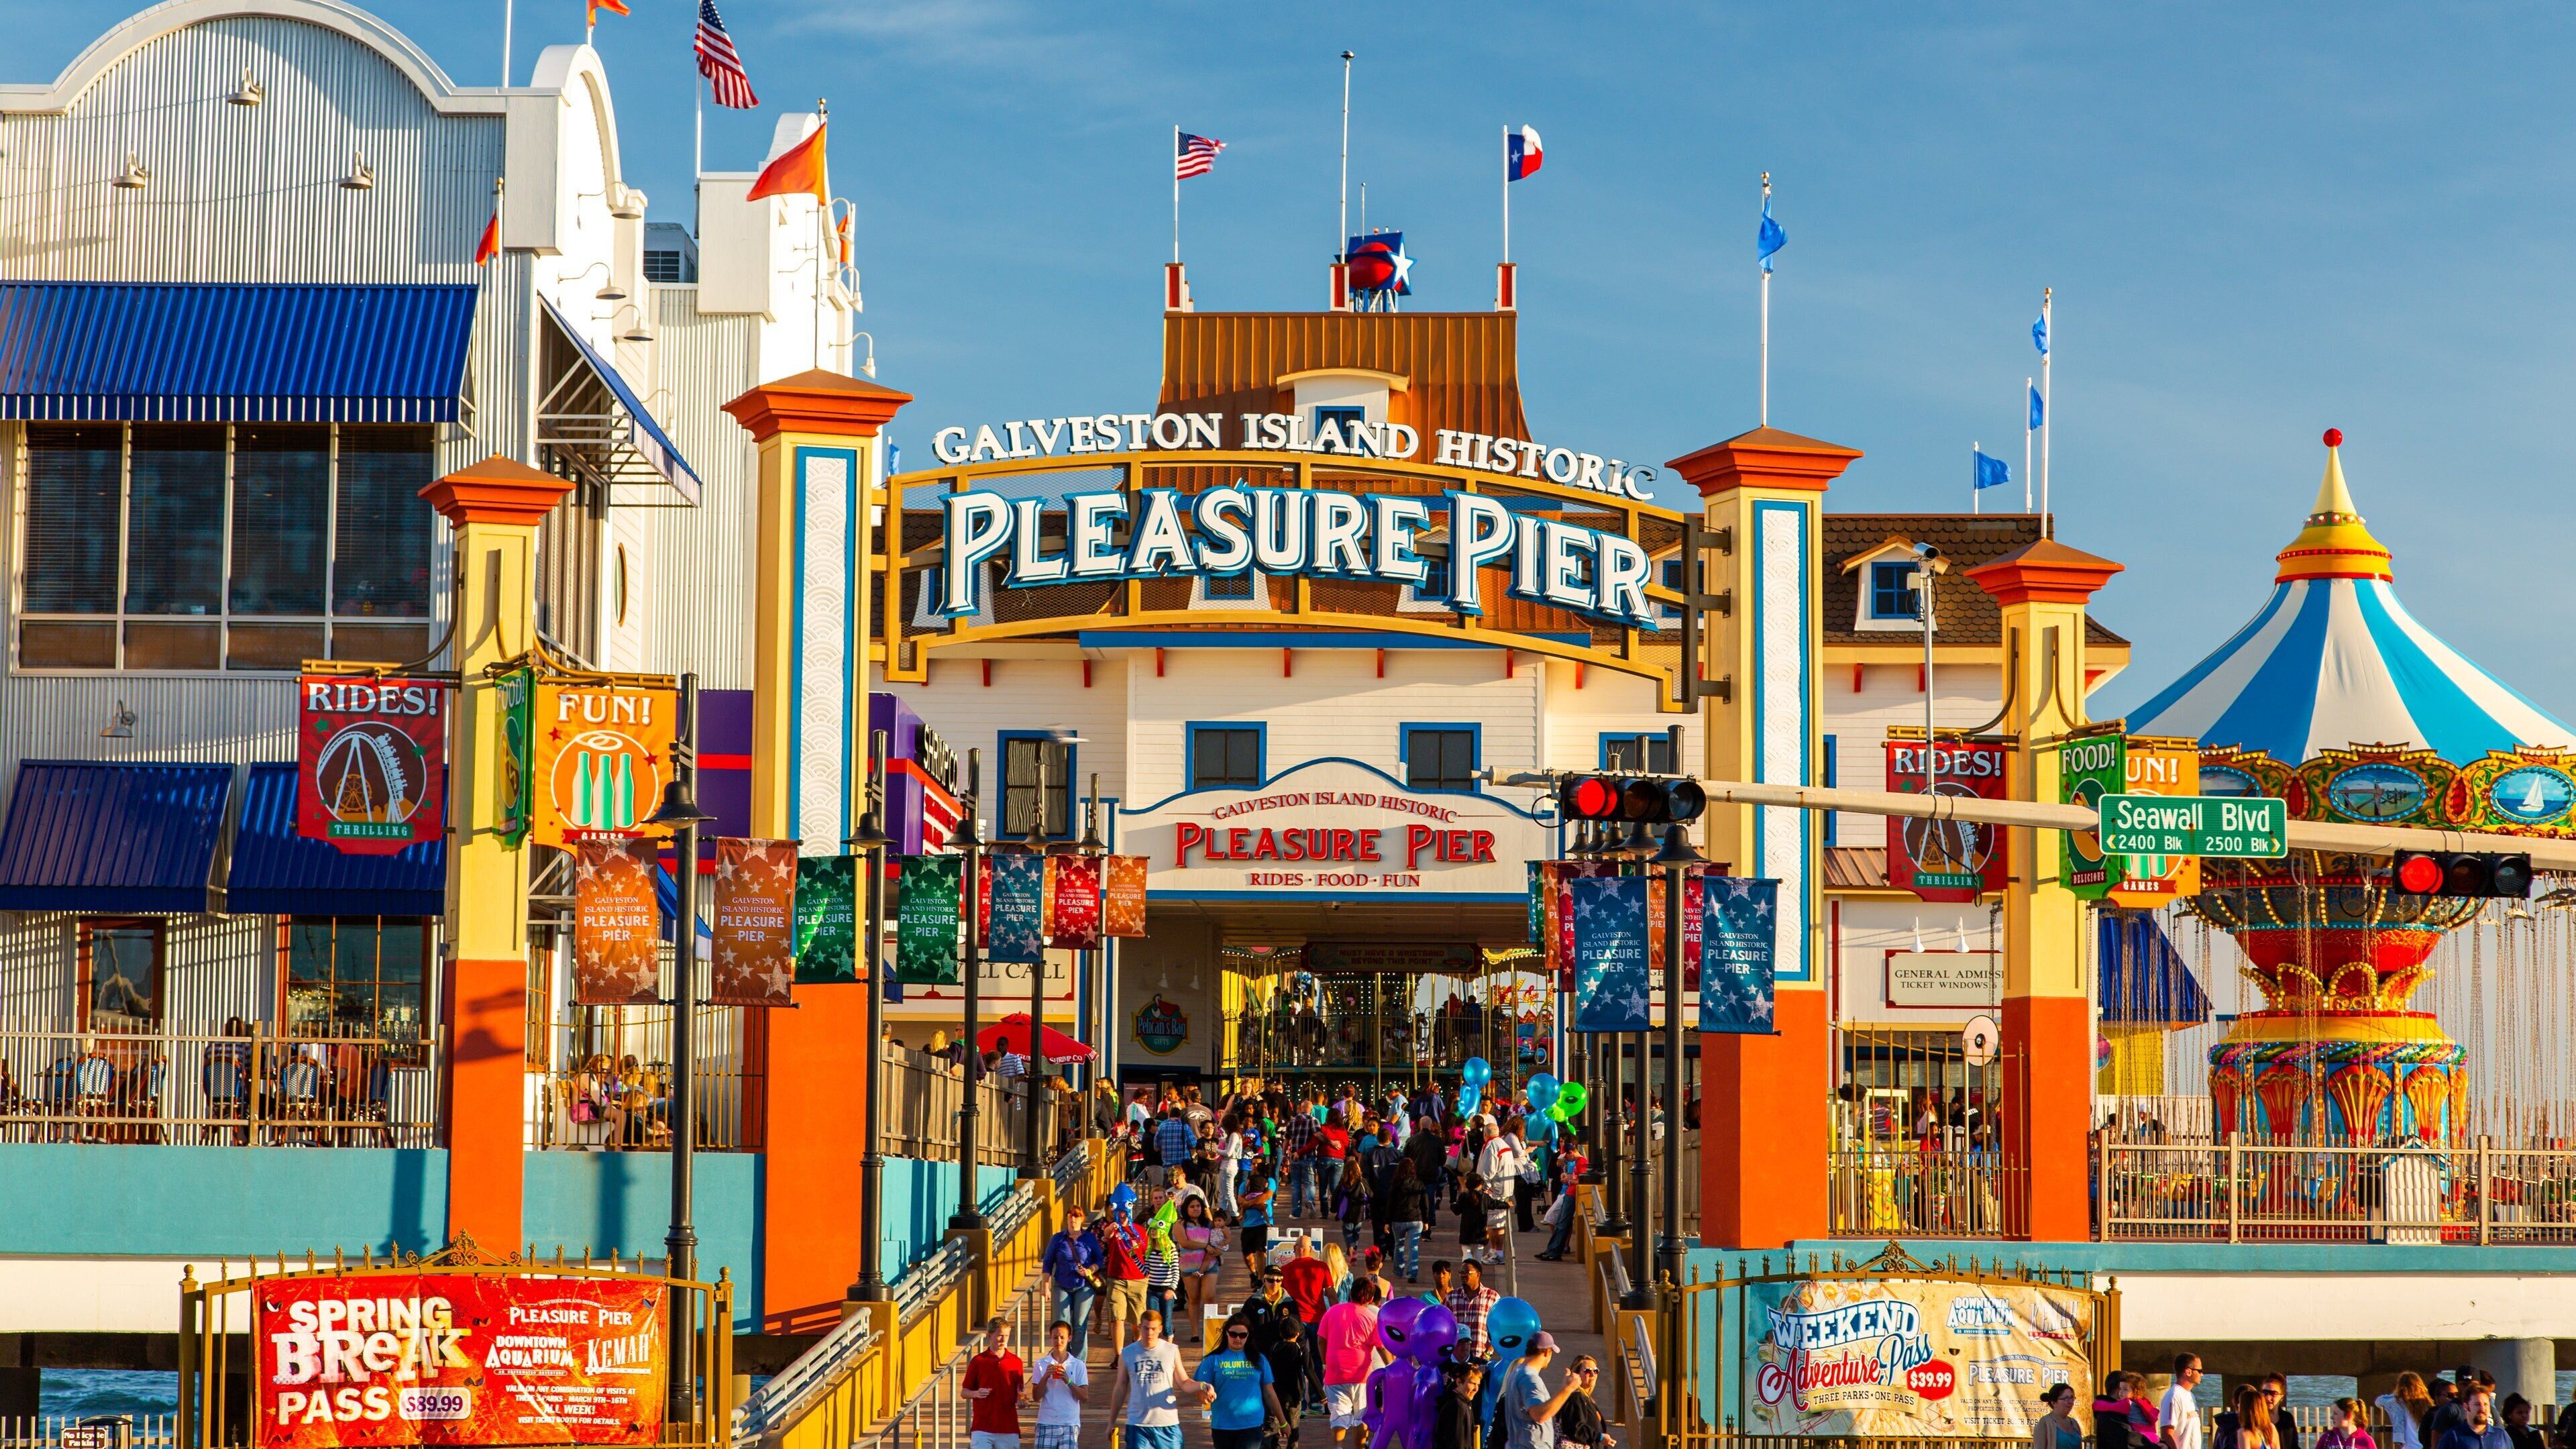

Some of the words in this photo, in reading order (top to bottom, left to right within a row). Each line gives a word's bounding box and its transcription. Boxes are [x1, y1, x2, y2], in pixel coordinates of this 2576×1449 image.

[932, 413, 1224, 465] GALVESTON
[1242, 413, 1419, 459] ISLAND
[1436, 429, 1658, 501] HISTORIC
[941, 480, 1430, 616] PLEASURE
[1443, 488, 1659, 632] PIER
[307, 682, 439, 716] RIDES!
[496, 676, 525, 714] FOOD!
[557, 693, 652, 726] FUN!
[1894, 747, 2002, 777] RIDES!
[2061, 741, 2115, 775] FOOD!
[2125, 757, 2179, 784] UN!
[1214, 793, 1312, 820] GALVESTON
[1314, 792, 1377, 807] ISLAND
[1380, 796, 1457, 823] HISTORIC
[2118, 801, 2203, 830] Seawall
[2222, 804, 2270, 832] Blvd
[335, 824, 408, 837] THRILLING
[1175, 822, 1382, 868] PLEASURE
[1406, 824, 1497, 870] PIER
[2118, 835, 2155, 850] 2400
[2164, 835, 2182, 850] Blk
[2206, 837, 2242, 851] 2500
[2251, 837, 2269, 852] Blk
[1250, 873, 1303, 886] RIDES
[1317, 873, 1369, 886] FOOD
[1382, 874, 1420, 887] FUN
[1919, 875, 1978, 885] THRILLIN
[2073, 871, 2104, 884] DELICIOUS
[2123, 881, 2159, 891] GAMES
[594, 896, 639, 904] GALVESTON
[807, 897, 843, 905] GALVESTON
[614, 905, 649, 913] HISTORIC
[995, 904, 1036, 913] PLEASURE
[584, 915, 650, 927] PLEASURE
[720, 915, 784, 928] PLEASURE
[798, 914, 853, 925] PLEASURE
[900, 914, 956, 925] PLEASURE
[1006, 914, 1024, 922] PIER
[602, 930, 631, 941] PIER
[737, 930, 765, 942] PIER
[813, 926, 836, 936] PIER
[915, 927, 939, 937] PIER
[1709, 939, 1735, 947] ISLAND
[1735, 941, 1768, 949] HISTORIC
[1582, 949, 1641, 960] PLEASURE
[1707, 949, 1768, 961] PLEASURE
[1599, 962, 1624, 973] PIER
[1724, 963, 1751, 975] PIER
[1894, 969, 1949, 979] GENERAL
[1955, 969, 2004, 979] ADMISSI
[1900, 981, 1934, 989] TICKET
[1939, 981, 1989, 989] WINDOWS
[1137, 1016, 1170, 1036] Pelican's
[1171, 1019, 1186, 1038] Bag
[288, 1297, 452, 1334] SPRING
[510, 1307, 589, 1326] PLEASURE
[598, 1309, 633, 1328] PIER
[1946, 1300, 2016, 1328] AQUARIUM
[1767, 1301, 1920, 1350] WEEKEND
[496, 1336, 567, 1348] DOWNTOWN
[485, 1343, 574, 1368] AQUARIUM
[587, 1334, 649, 1376] KEMAH
[1134, 1360, 1164, 1373] USA
[1756, 1347, 1881, 1412] Adventure
[1876, 1332, 1933, 1386] Pass
[1911, 1372, 1951, 1389] $39.99
[1969, 1364, 2035, 1387] PLEASURE
[2041, 1366, 2070, 1388] PIER
[406, 1395, 463, 1413] $89.99
[1813, 1392, 1839, 1404] THREE
[1843, 1391, 1869, 1399] PARKS
[1875, 1391, 1891, 1401] ONE
[1894, 1393, 1915, 1405] PASS
[278, 1387, 391, 1425] PASS
[564, 1405, 596, 1414] WEEK!
